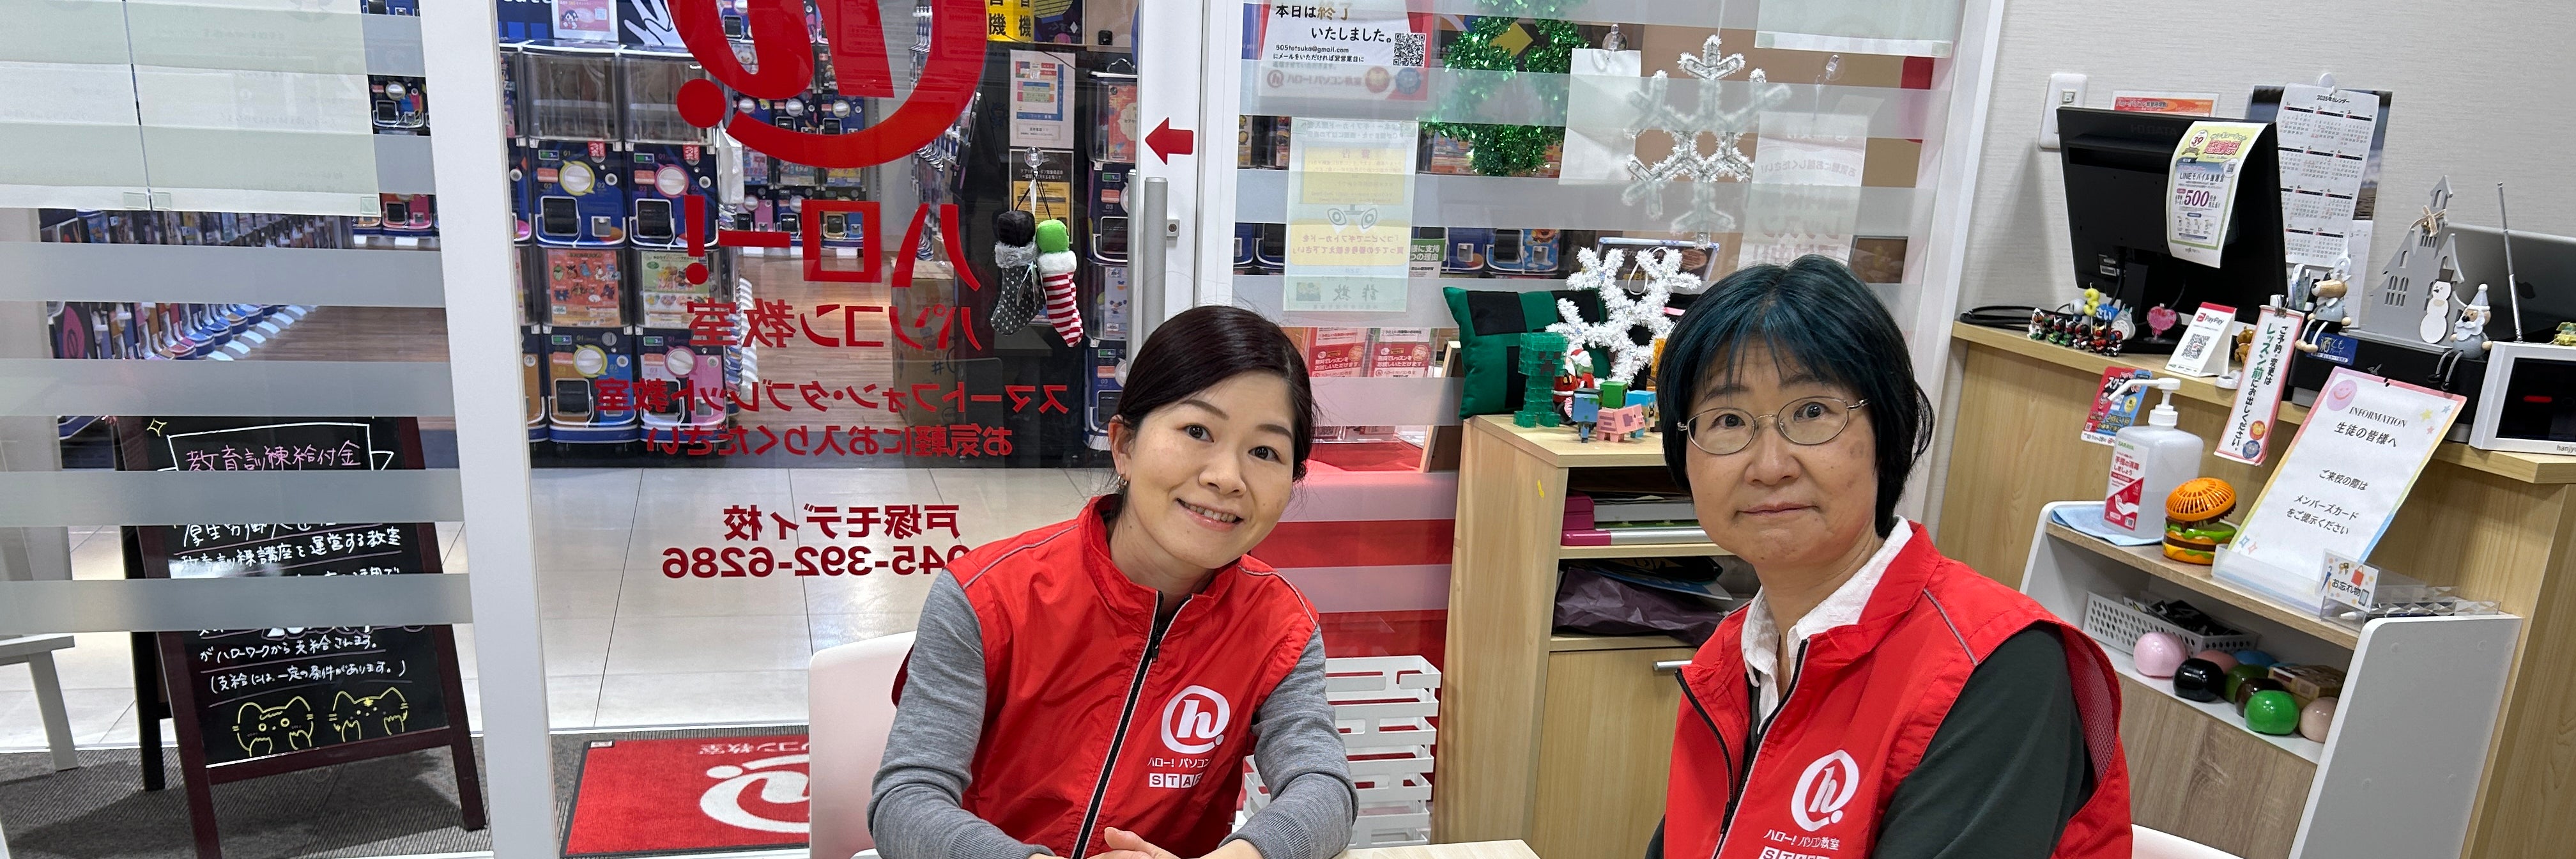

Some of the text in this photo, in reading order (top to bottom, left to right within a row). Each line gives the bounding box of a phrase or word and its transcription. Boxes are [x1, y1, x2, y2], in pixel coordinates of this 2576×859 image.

[1311, 27, 1392, 43] いたしました。
[2191, 136, 2204, 145] 39
[2184, 190, 2210, 207] 500
[2084, 288, 2100, 316] 3
[2205, 316, 2225, 325] PayPay
[2231, 323, 2276, 451] レッスン前にお出しください。
[2349, 406, 2408, 428] INFORMATION
[2334, 421, 2397, 447] 生徒の皆様へ
[185, 440, 361, 471] 教育訓練給付金
[2319, 469, 2368, 491] ご来校の際は
[2294, 495, 2359, 520] メンバーズカード
[2287, 508, 2349, 535] をご提示ください
[2331, 578, 2361, 597] お忘れ物
